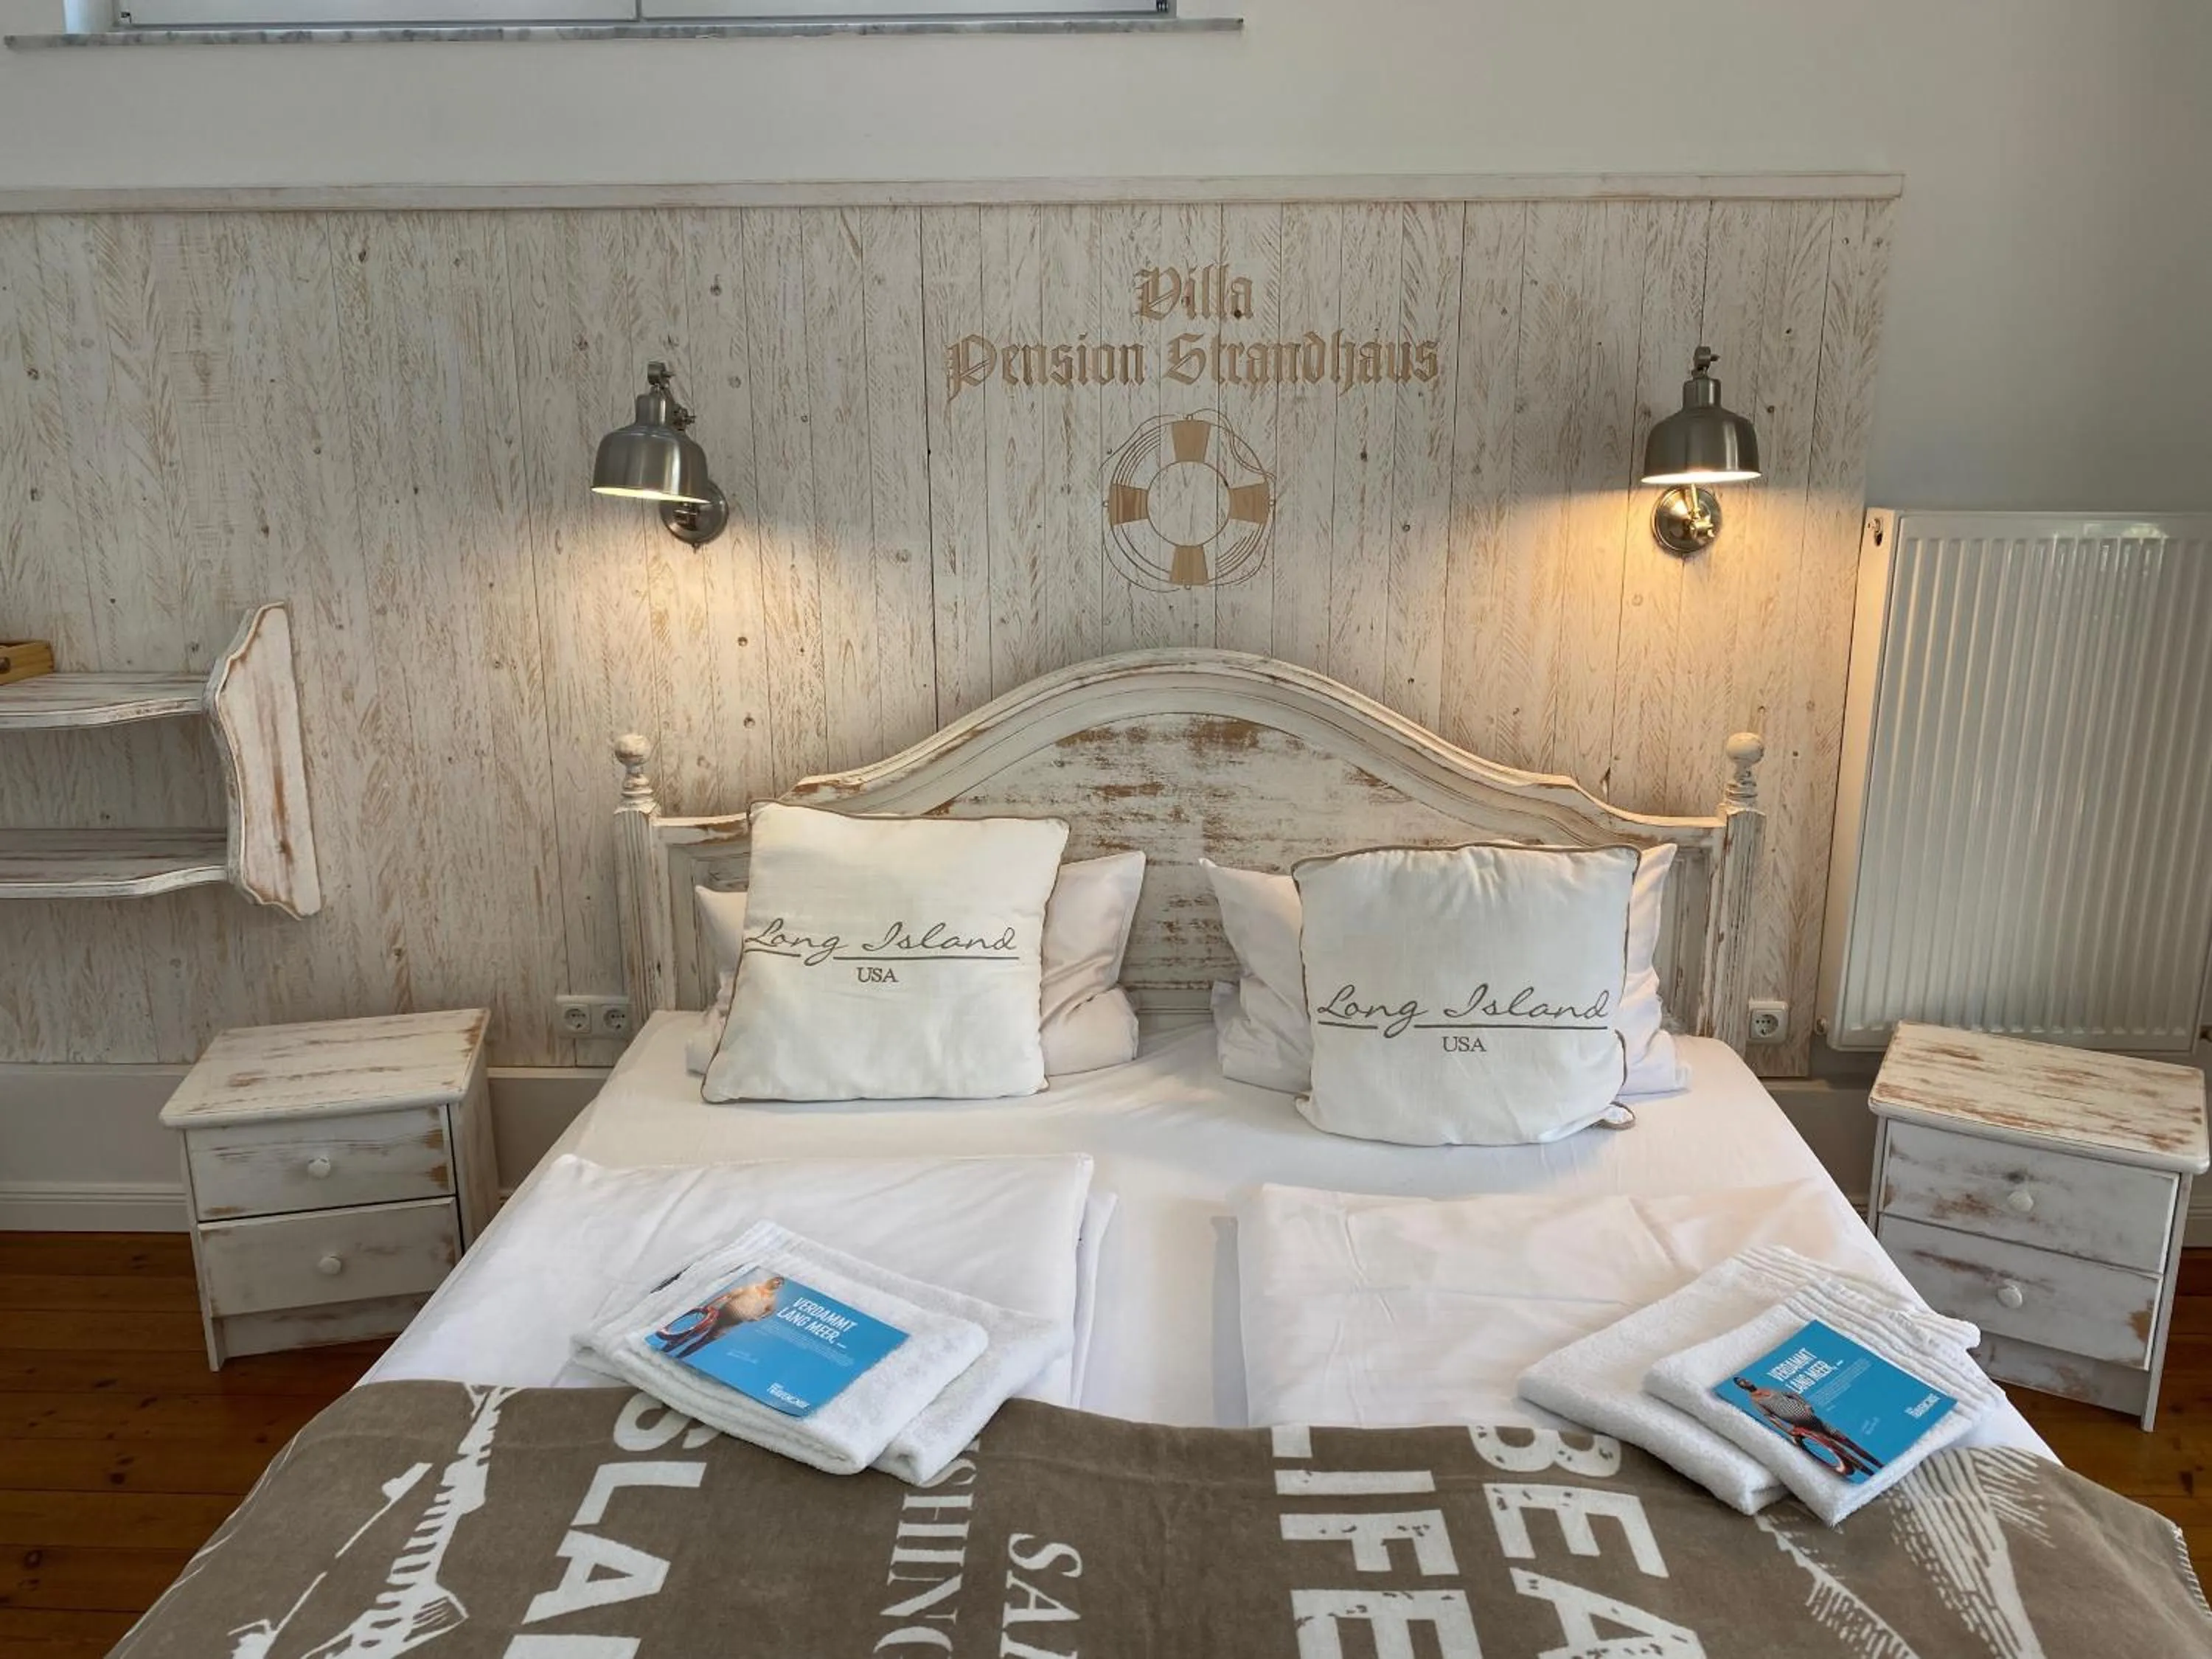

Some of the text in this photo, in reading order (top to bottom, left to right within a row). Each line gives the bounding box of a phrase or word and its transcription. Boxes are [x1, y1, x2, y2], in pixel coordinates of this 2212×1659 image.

[1133, 262, 1255, 321] Villa
[946, 330, 1439, 402] Pension Strandhaus
[744, 917, 1018, 967] Long Island
[856, 966, 899, 984] USA
[1318, 983, 1609, 1038] Long Island
[1442, 1036, 1487, 1052] USA
[776, 1307, 811, 1326] LANG
[793, 1297, 858, 1332] VERDAMMT
[502, 1391, 724, 1659] SLA
[1271, 1426, 1482, 1659] IFE
